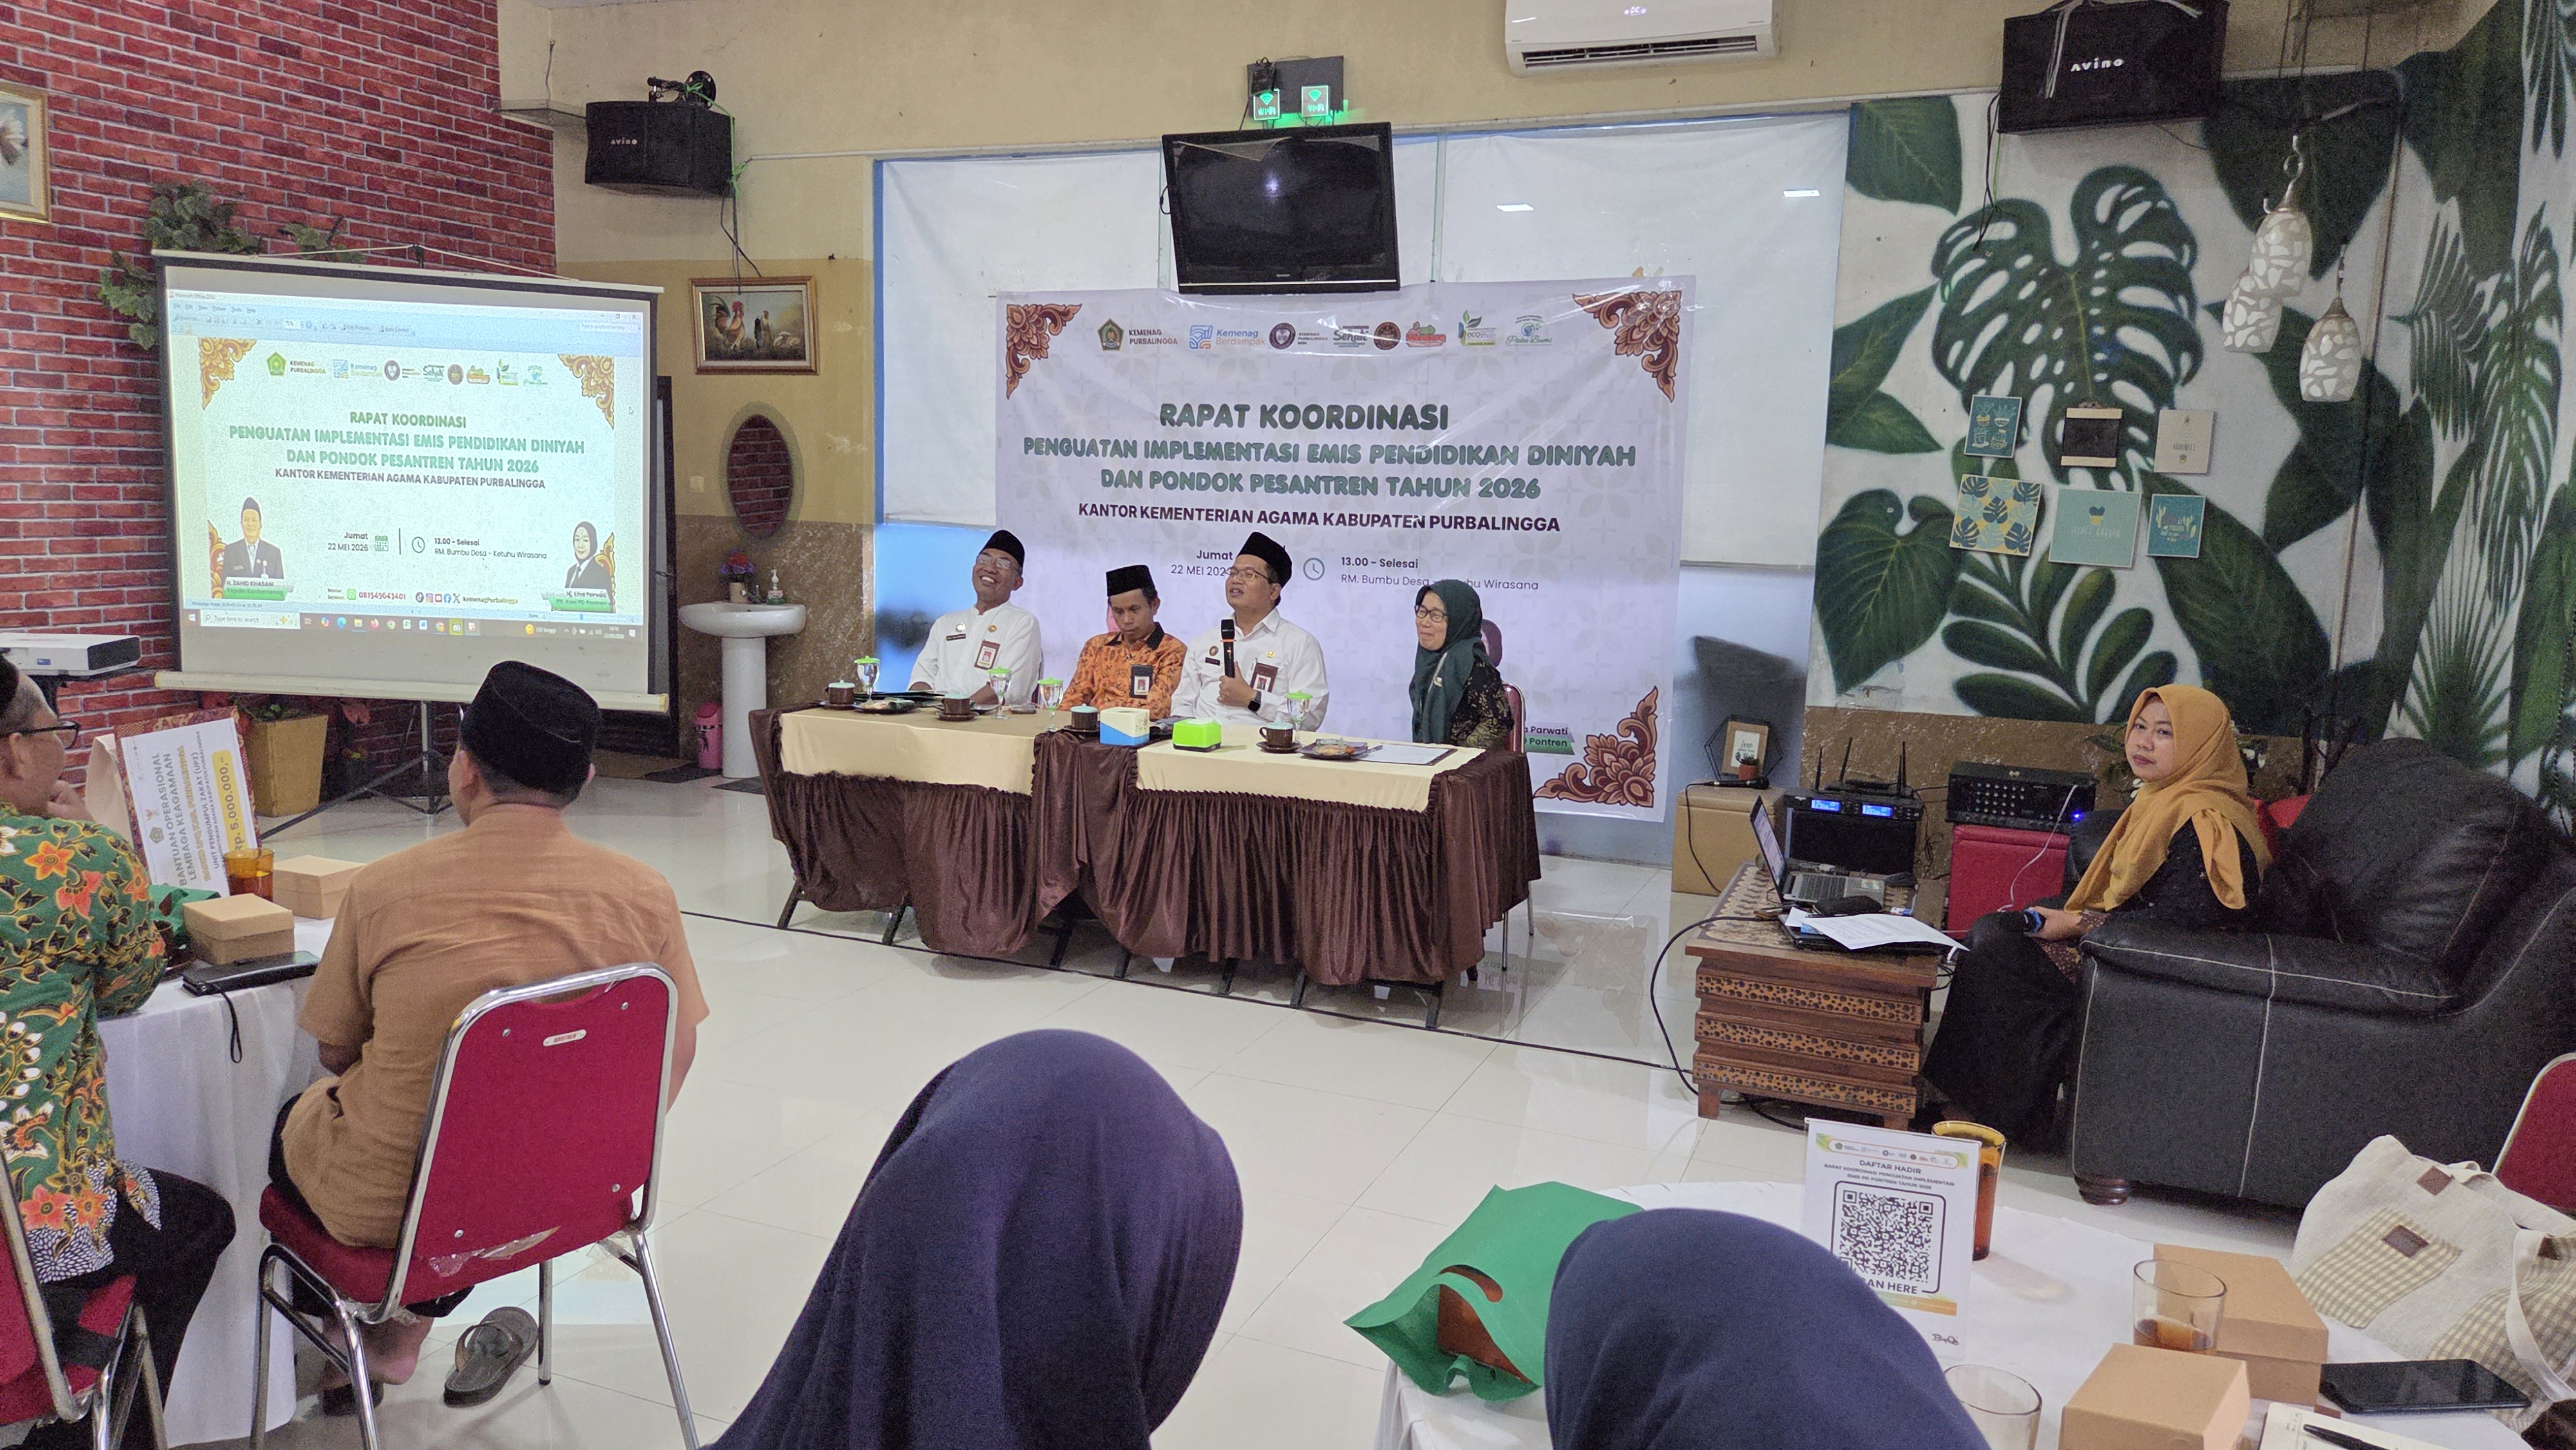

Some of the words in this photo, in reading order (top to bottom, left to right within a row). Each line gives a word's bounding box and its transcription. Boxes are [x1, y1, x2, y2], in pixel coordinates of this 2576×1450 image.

[1216, 337, 1265, 346] Berdampak
[1217, 329, 1258, 338] Kemenag
[350, 411, 388, 424] RAPAT
[392, 413, 466, 428] KOORDINASI
[1159, 403, 1250, 428] RAPAT
[1260, 404, 1448, 430] KOORDINASI
[229, 425, 310, 442] PENGUATAN
[315, 429, 409, 446] IMPLEMENTASI
[414, 434, 444, 448] EMIS
[449, 435, 526, 452] PENDIDIKAN
[531, 439, 584, 454] DINIYAH
[287, 449, 315, 463] DAN
[319, 451, 377, 466] PONDOK
[381, 453, 454, 469] PESANTREN
[458, 457, 503, 471] TAHUN
[507, 458, 539, 473] 2026
[1024, 437, 1137, 458] PENGUATAN
[1144, 440, 1299, 464] IMPLEMENTASI
[1307, 443, 1361, 464] EMIS
[1369, 444, 1519, 466] PENDIDIKAN
[1528, 445, 1636, 467] DINIYAH
[275, 468, 315, 479] KANTOR
[317, 470, 384, 482] KEMENTERIAN
[386, 473, 421, 484] AGAMA
[423, 475, 478, 486] KABUPATEN
[480, 477, 545, 489] PURBALINGGA
[1101, 469, 1143, 489] DAN
[1149, 471, 1244, 493] PONDOK
[1250, 473, 1378, 496] PESANTREN
[1386, 476, 1471, 498] TAHUN
[1478, 478, 1541, 500] 2026
[1079, 503, 1137, 518] KANTOR
[1141, 505, 1253, 523] KEMENTERIAN
[1256, 510, 1319, 526] AGAMA
[1323, 513, 1425, 529] KABUPATEN
[1430, 515, 1560, 532] PURBALINGGA
[344, 532, 368, 540] Jumat
[352, 543, 368, 552] 2026
[493, 550, 515, 558] Ketuhu
[1197, 550, 1233, 560] Jumat
[1171, 564, 1184, 574] 22
[1186, 565, 1204, 576] MEI
[1341, 557, 1368, 567] 13.00
[1379, 558, 1419, 569] Selesai
[1341, 574, 1359, 585] RM.
[1362, 575, 1399, 586] Bumbu
[1402, 576, 1430, 587] Desa
[1484, 579, 1539, 590] Wirasana
[1531, 726, 1568, 735] Parwati
[196, 730, 207, 769] PURBALINGGA
[1530, 738, 1567, 747] Pontren
[191, 752, 202, 774] (UPZ)
[152, 752, 175, 830] OPERASIONAL
[163, 753, 185, 827] KEAGAMAAN
[196, 775, 206, 802] ZAKAT
[203, 770, 214, 803] KABUPATEN
[219, 756, 240, 830] 5.000.000,-
[202, 802, 216, 849] PENGUMPUL
[170, 831, 187, 886] BANTUAN
[180, 829, 197, 880] LEMBAGA
[211, 849, 220, 869] UNIT
[1844, 1167, 1877, 1175] KOORDINASI
[1879, 1171, 1912, 1181] PENGUATAN
[1914, 1176, 1955, 1186] IMPLEMENTASI
[1859, 1160, 1892, 1171] DAFTAR
[1895, 1165, 1921, 1174] HADIR
[1871, 1177, 1897, 1185] PONTREN
[1888, 1282, 1918, 1294] HERE
